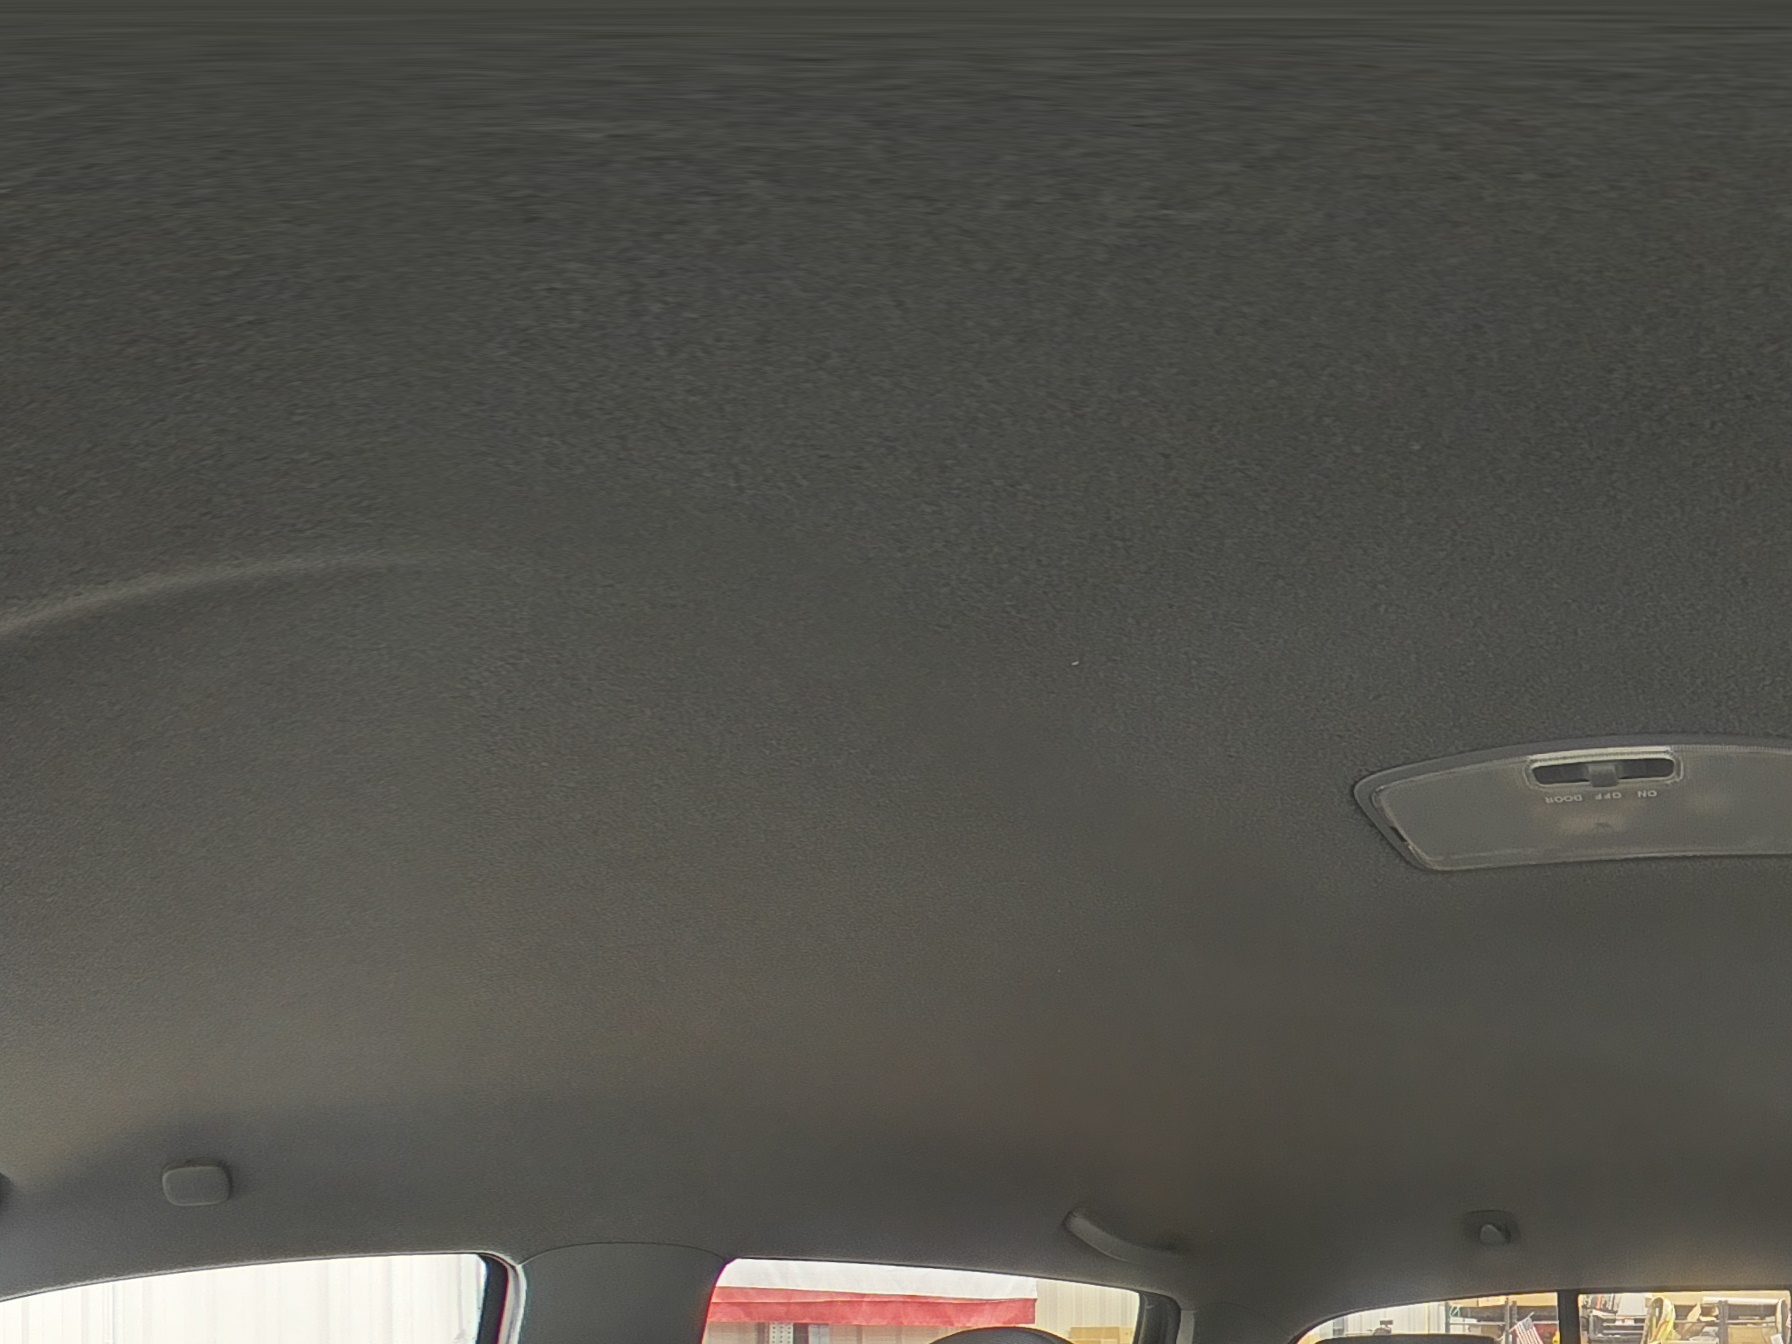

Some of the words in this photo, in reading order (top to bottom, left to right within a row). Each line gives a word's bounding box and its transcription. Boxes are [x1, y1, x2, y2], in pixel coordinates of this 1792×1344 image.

[1595, 792, 1622, 800] OFF
[1638, 790, 1657, 798] ON
[1545, 794, 1583, 804] DOOR
